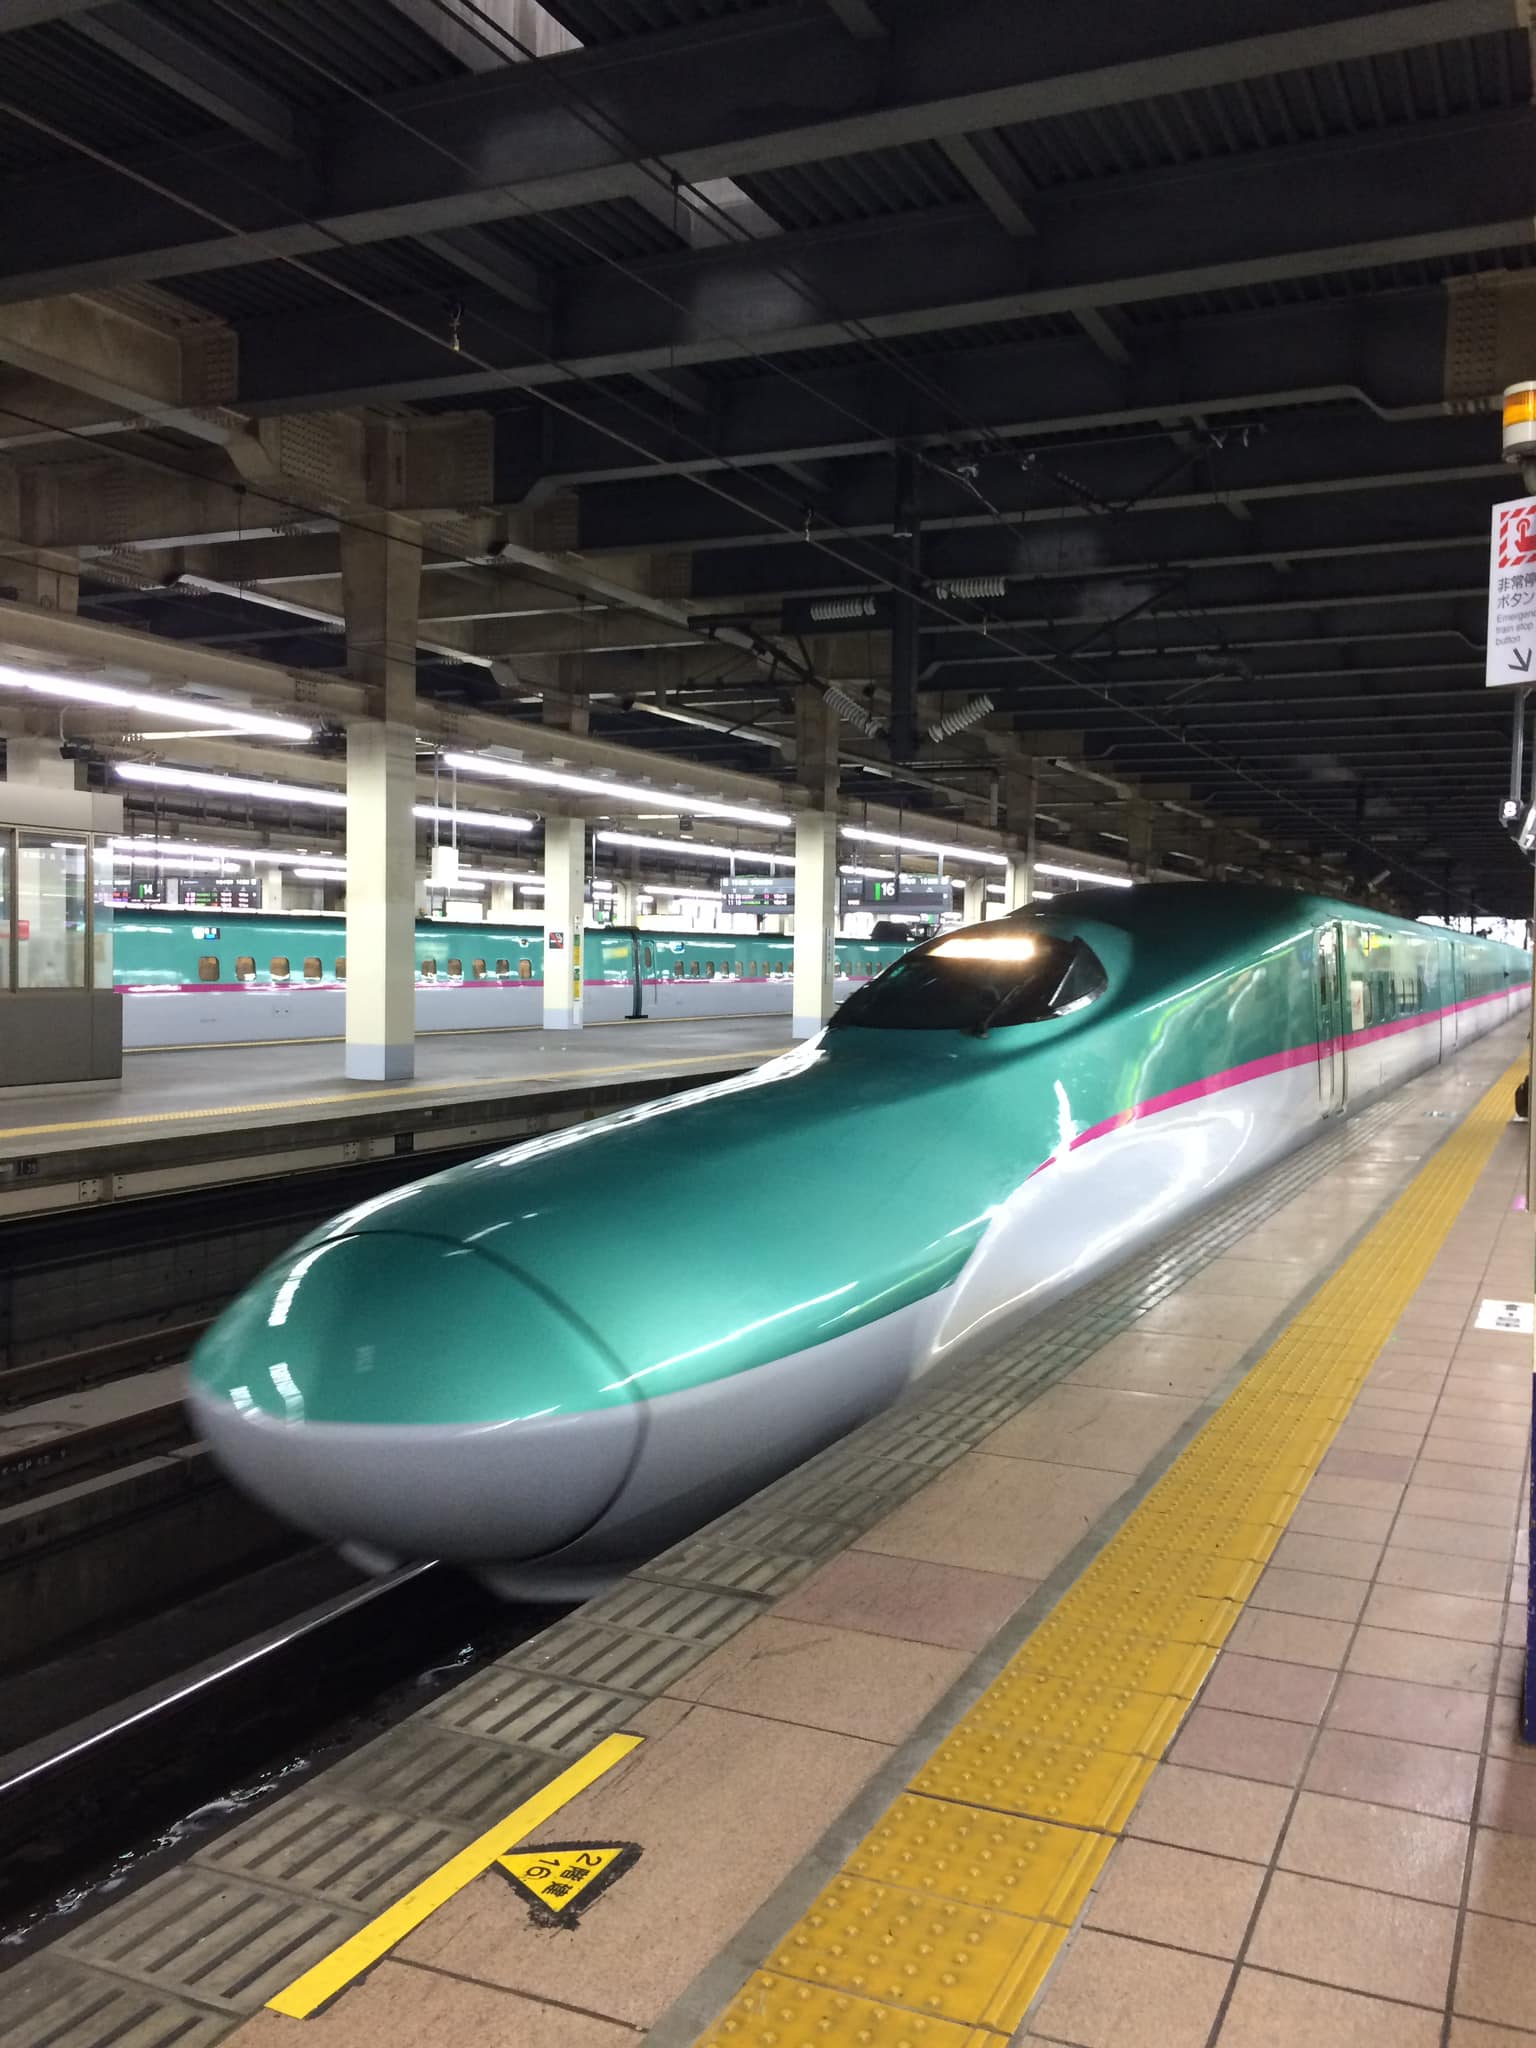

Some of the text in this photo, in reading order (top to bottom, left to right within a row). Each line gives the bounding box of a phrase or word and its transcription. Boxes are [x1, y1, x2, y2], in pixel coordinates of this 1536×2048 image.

[1497, 592, 1535, 609] ボタン
[1516, 622, 1534, 632] stop
[1496, 635, 1521, 646] button
[1504, 801, 1517, 817] 8
[144, 883, 154, 896] 14
[881, 882, 896, 897] 16
[525, 1858, 561, 1880] 16
[541, 1852, 603, 1898] 2階建
